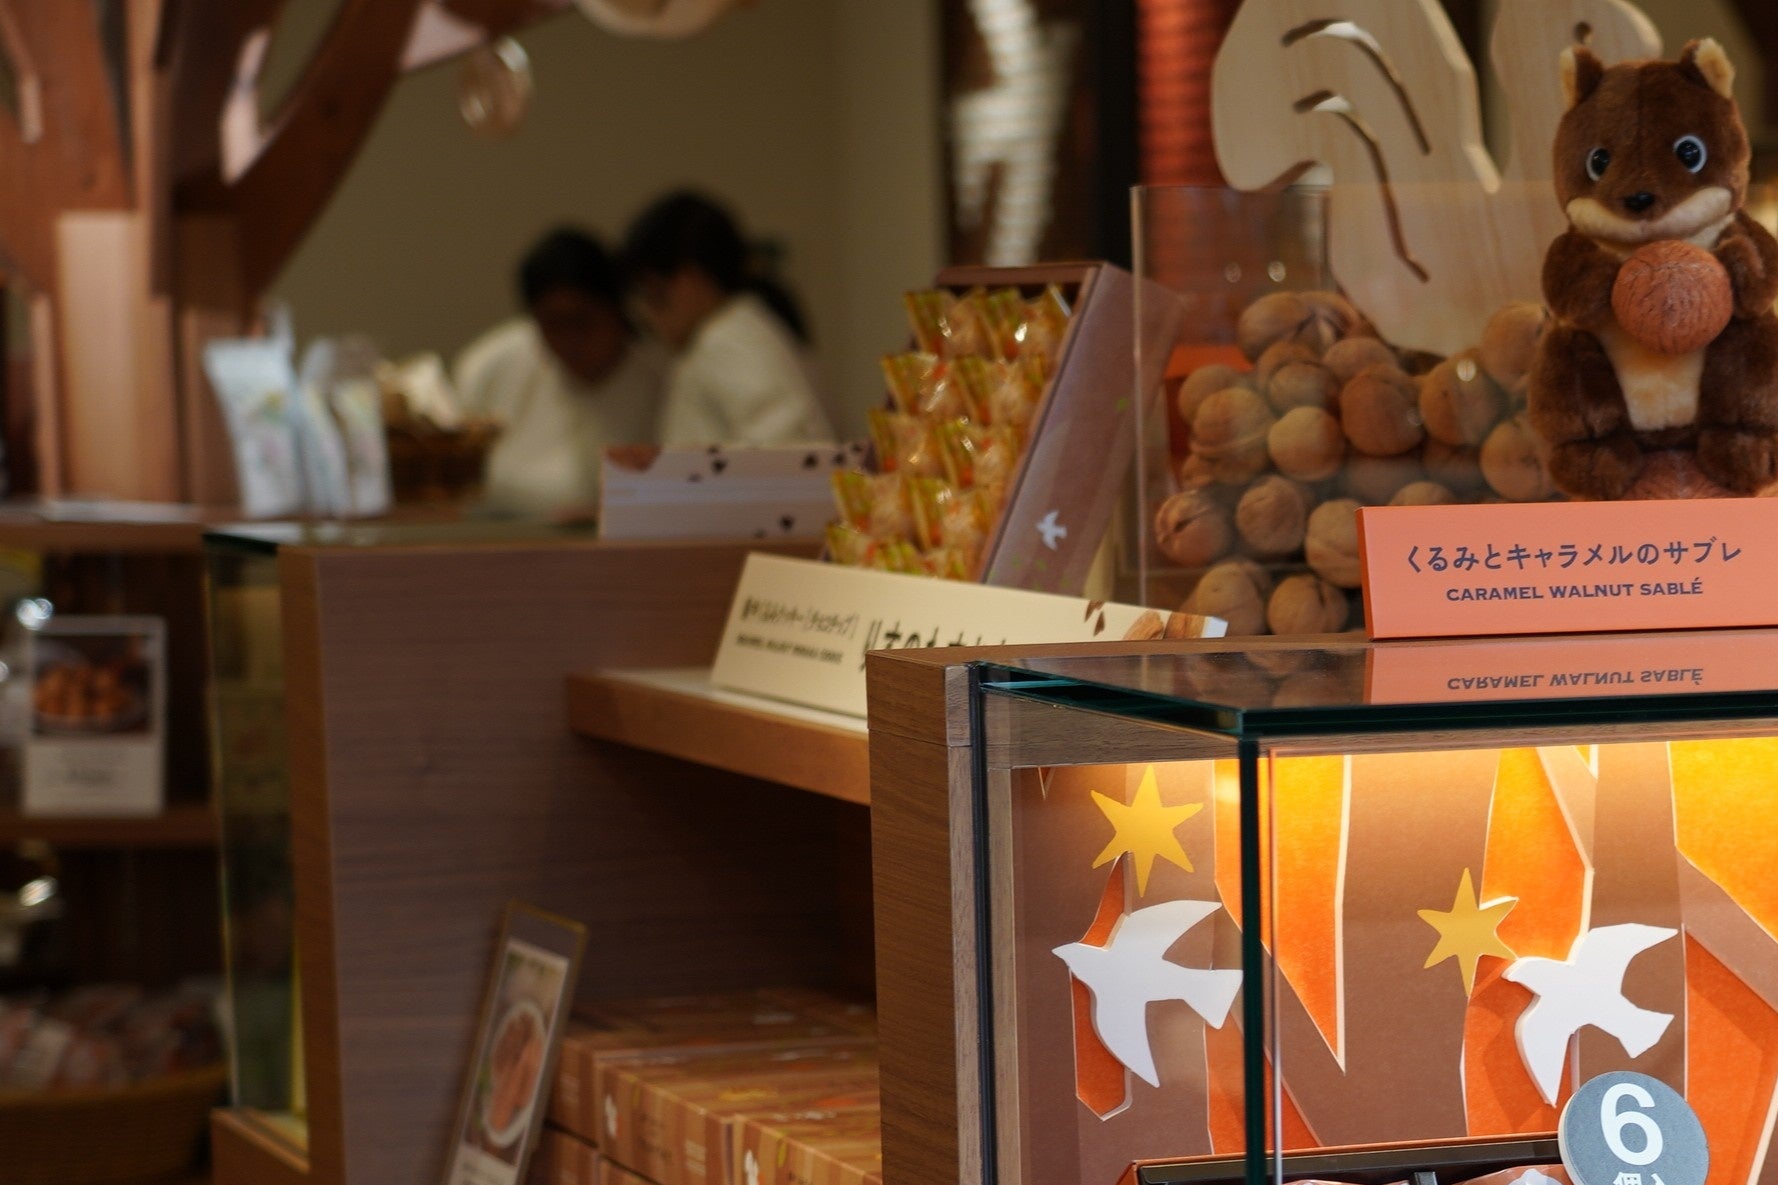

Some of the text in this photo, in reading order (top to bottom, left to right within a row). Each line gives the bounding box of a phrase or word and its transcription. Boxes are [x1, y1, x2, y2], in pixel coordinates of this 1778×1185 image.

[1407, 536, 1741, 573] くるみとキャラメルのサブレ
[1446, 577, 1703, 601] CARAMEL WALNUT SABLÉ
[1600, 1083, 1664, 1165] 6
